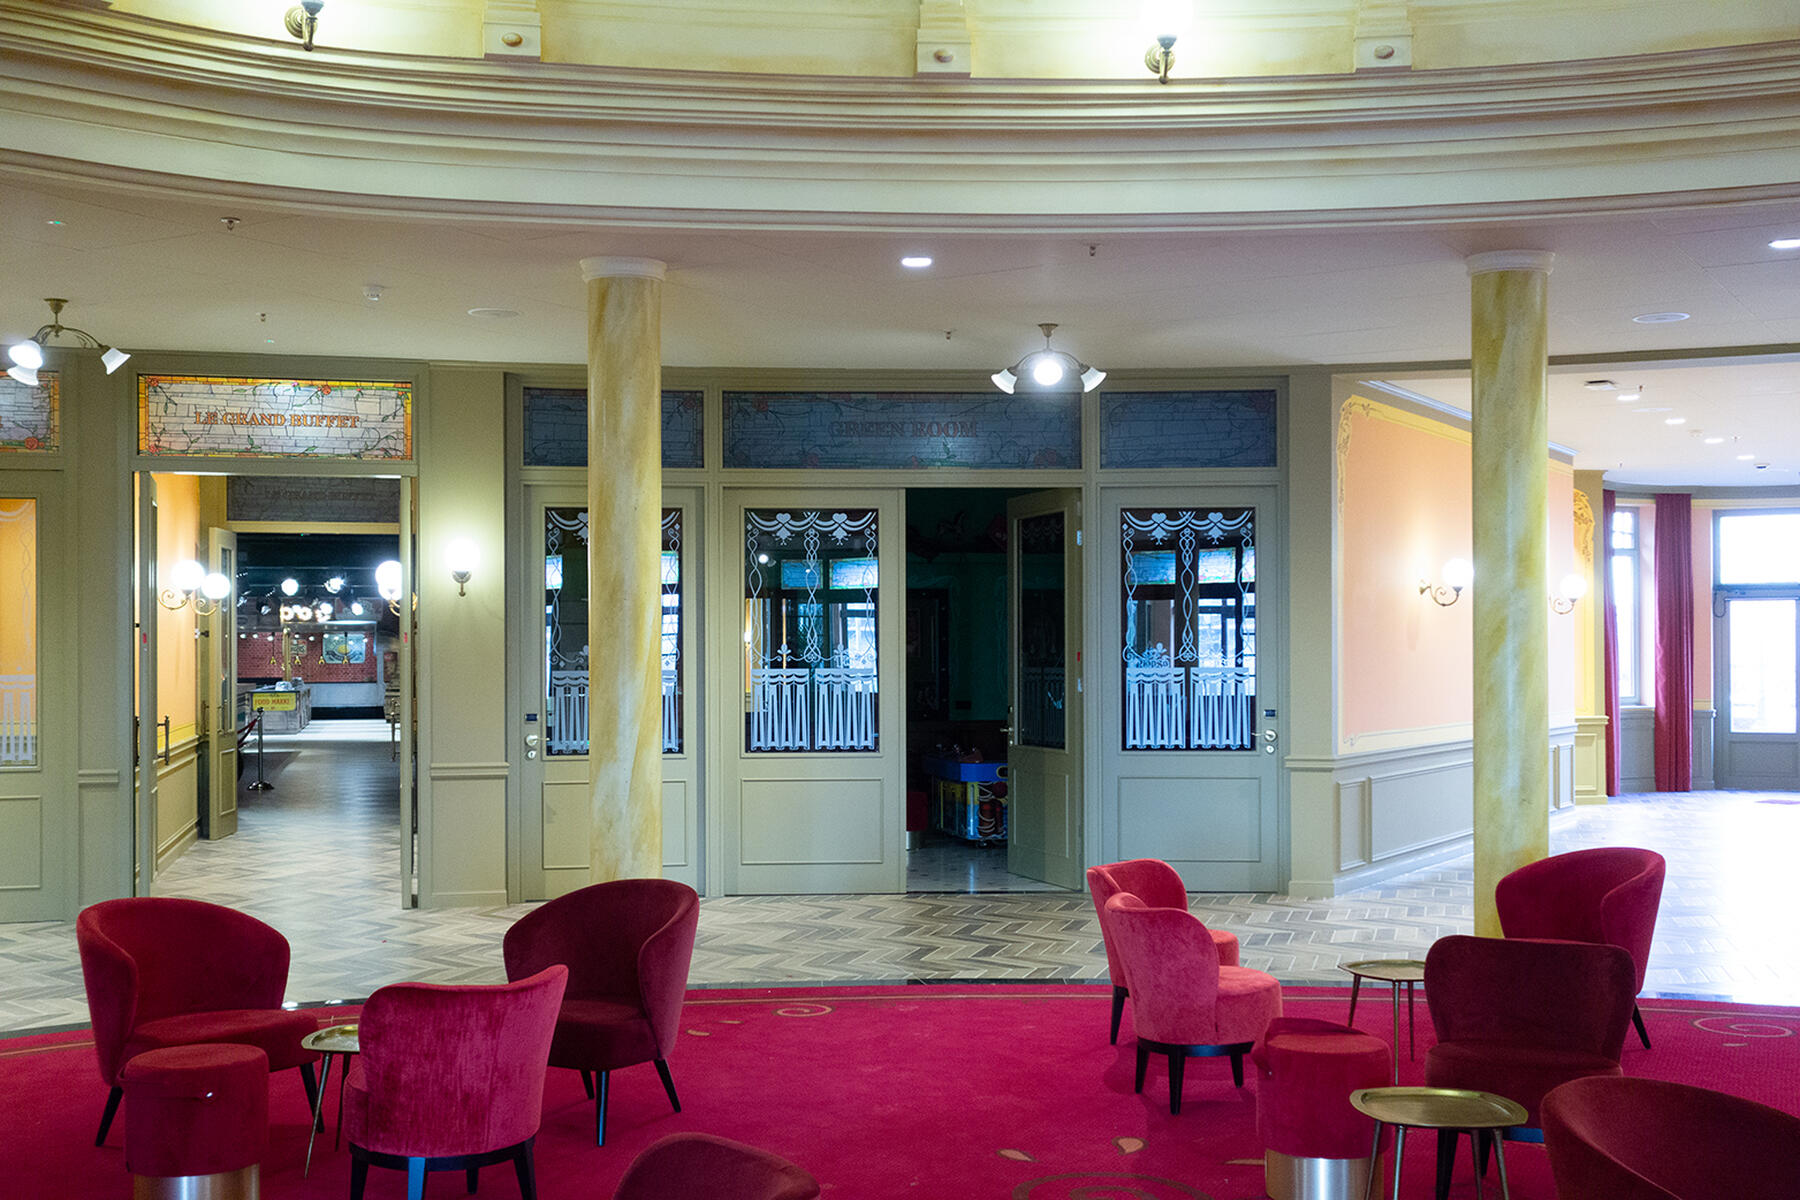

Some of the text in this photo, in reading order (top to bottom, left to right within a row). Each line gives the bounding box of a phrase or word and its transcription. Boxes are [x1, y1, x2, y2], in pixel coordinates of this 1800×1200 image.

[194, 411, 360, 428] LE GRAND BUFFET
[828, 420, 977, 437] GREEN ROOM
